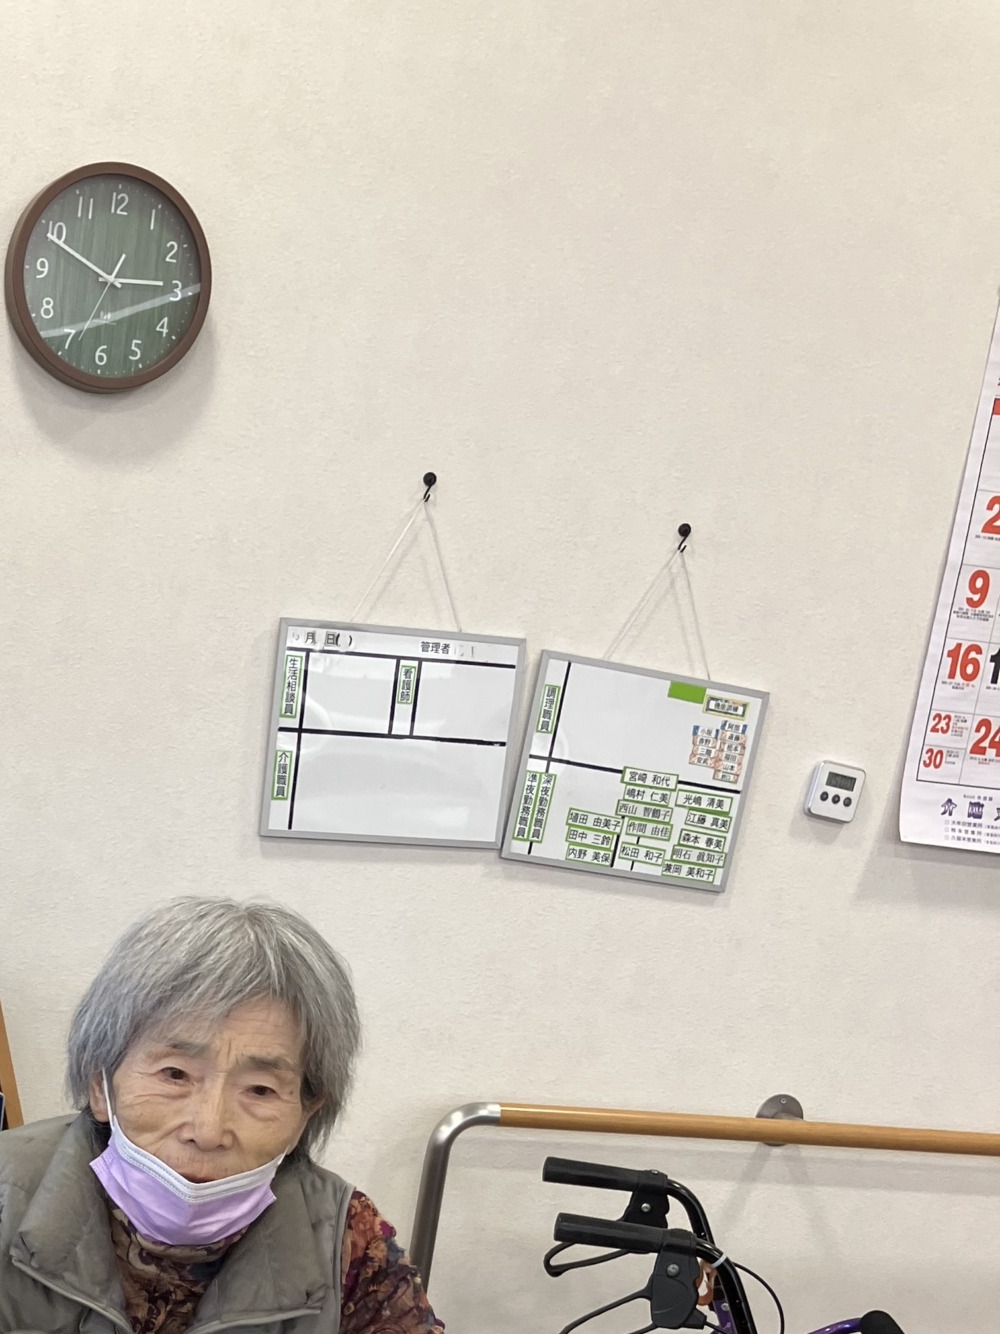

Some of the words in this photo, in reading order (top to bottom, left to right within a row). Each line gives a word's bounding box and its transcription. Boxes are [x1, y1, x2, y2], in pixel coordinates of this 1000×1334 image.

[78, 196, 94, 220] 11
[111, 192, 129, 216] 12
[150, 209, 156, 231] 1
[47, 220, 67, 245] 10
[165, 241, 178, 263] 2
[35, 258, 49, 279] 9
[169, 280, 182, 301] 3
[40, 297, 54, 319] 8
[156, 317, 169, 337] 4
[63, 328, 76, 350] 7
[129, 339, 142, 360] 5
[95, 345, 107, 365] 6
[966, 569, 990, 608] 9
[420, 641, 450, 654] 管理者
[946, 642, 982, 683] 16
[284, 658, 299, 714] 生活相談員
[400, 668, 414, 701] 看護師
[540, 688, 558, 732] 調理職員
[930, 712, 951, 735] 23
[923, 748, 944, 770] 30
[275, 751, 289, 797] 介護職員
[652, 774, 670, 787] 和代
[626, 788, 645, 800] 嶋村
[650, 791, 668, 803] 仁美
[706, 797, 724, 809] 清美
[618, 803, 637, 815] 西山
[593, 816, 621, 831] 由美子
[627, 822, 646, 834] 作間
[651, 825, 669, 837] 由佳
[688, 813, 706, 825] 江藤
[710, 816, 729, 829] 真美
[568, 830, 587, 841] 田中
[682, 832, 700, 845] 森本
[568, 847, 587, 859] 内野
[591, 850, 610, 863] 美保
[620, 845, 639, 859] 松田
[643, 849, 663, 862] 和子
[686, 866, 714, 880] 美和子
